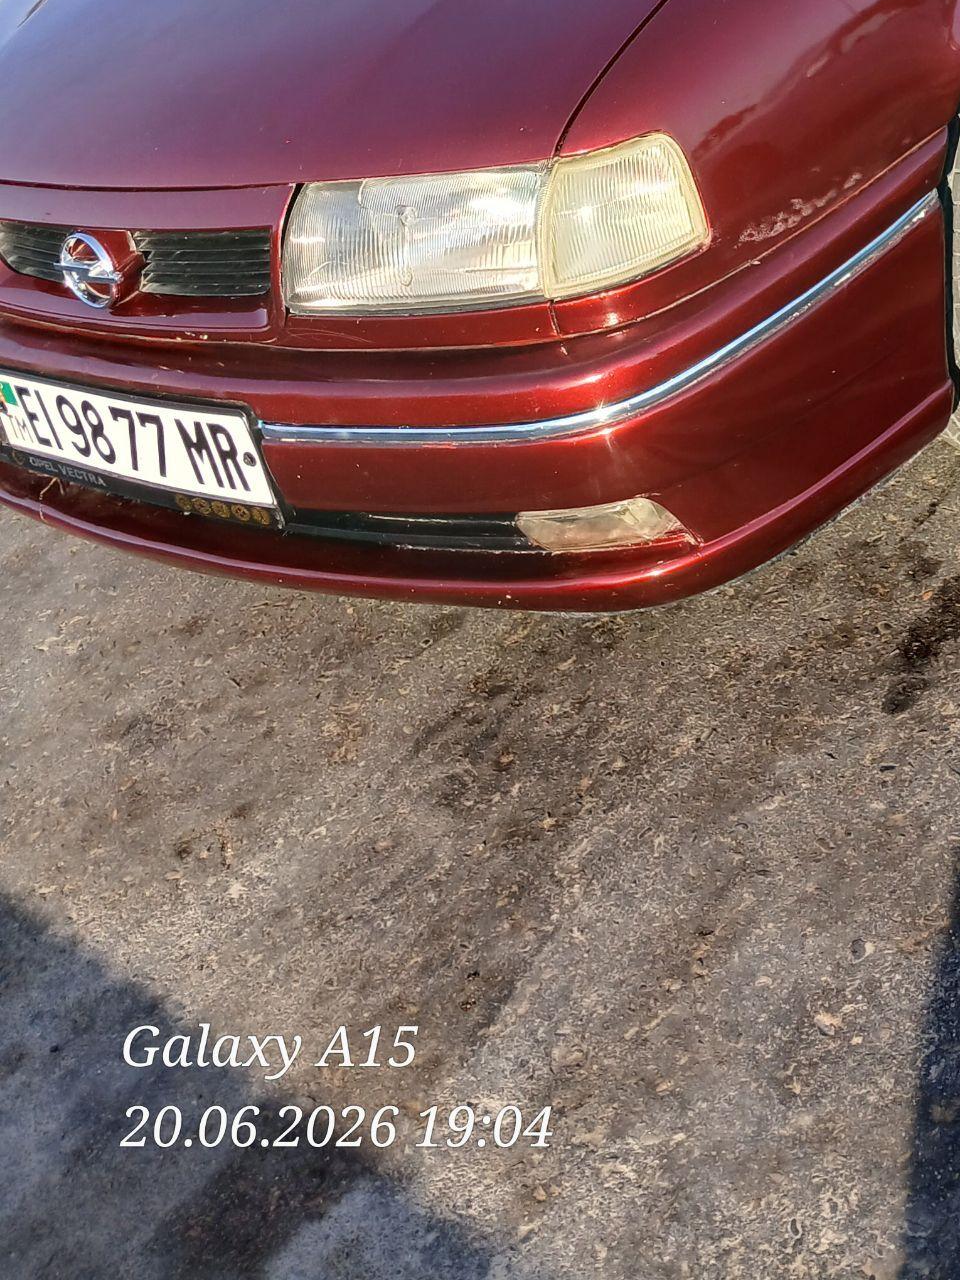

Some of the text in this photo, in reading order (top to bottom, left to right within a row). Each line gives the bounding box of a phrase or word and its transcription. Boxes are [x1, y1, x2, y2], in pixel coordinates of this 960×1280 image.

[29, 456, 107, 487] OPEL VECTRA
[56, 395, 167, 478] 9877
[174, 418, 251, 492] MR
